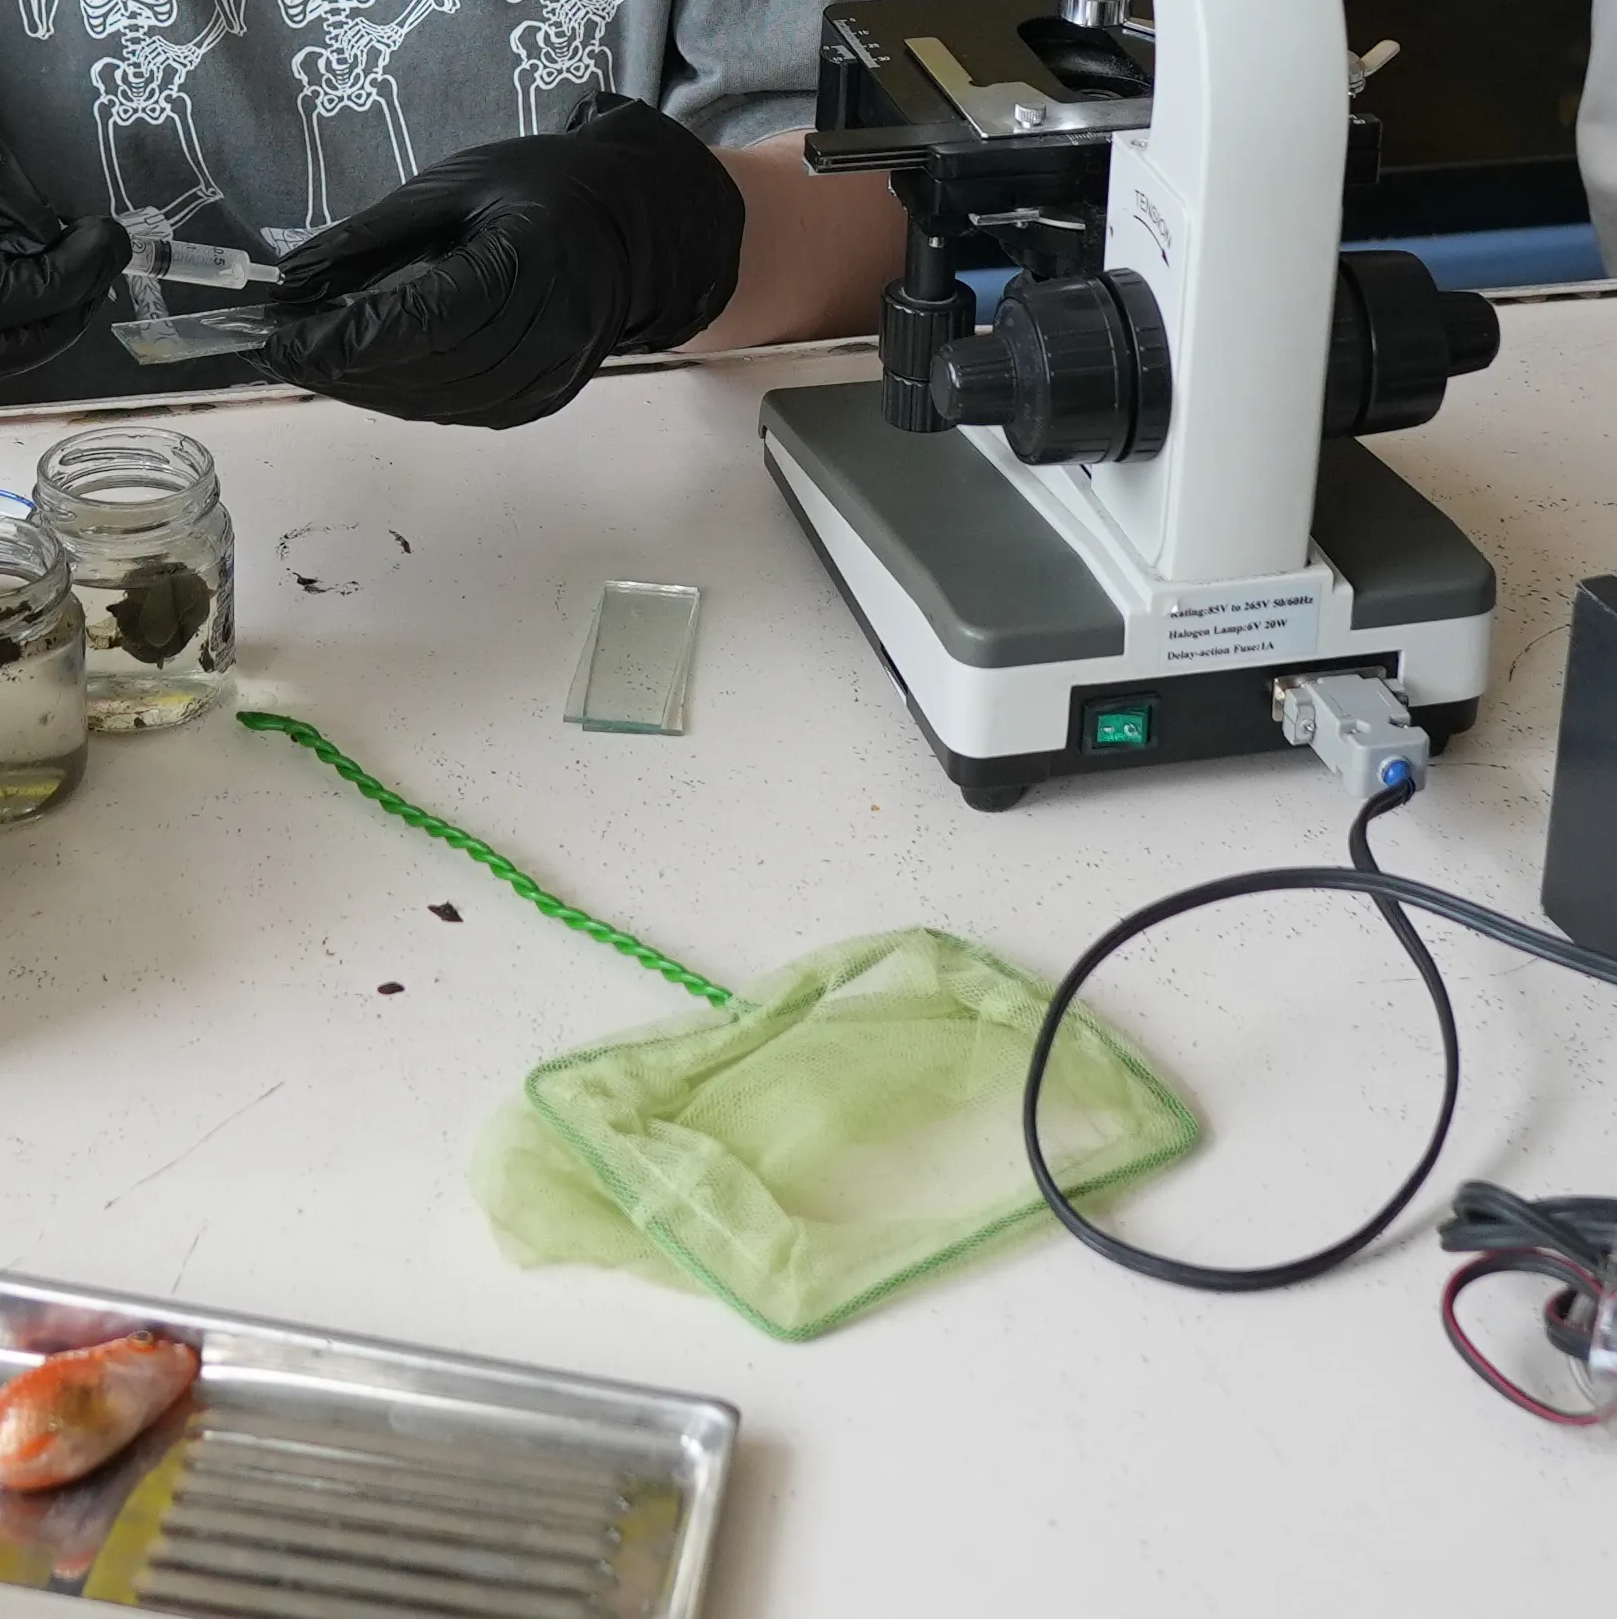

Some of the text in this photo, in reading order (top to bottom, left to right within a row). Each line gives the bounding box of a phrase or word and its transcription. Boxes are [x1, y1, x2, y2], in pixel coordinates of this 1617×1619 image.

[1134, 189, 1173, 249] TENSION
[1168, 618, 1288, 640] Halogen Lamp:6V 20W
[1167, 641, 1275, 661] Delay-action Fuse:1A
